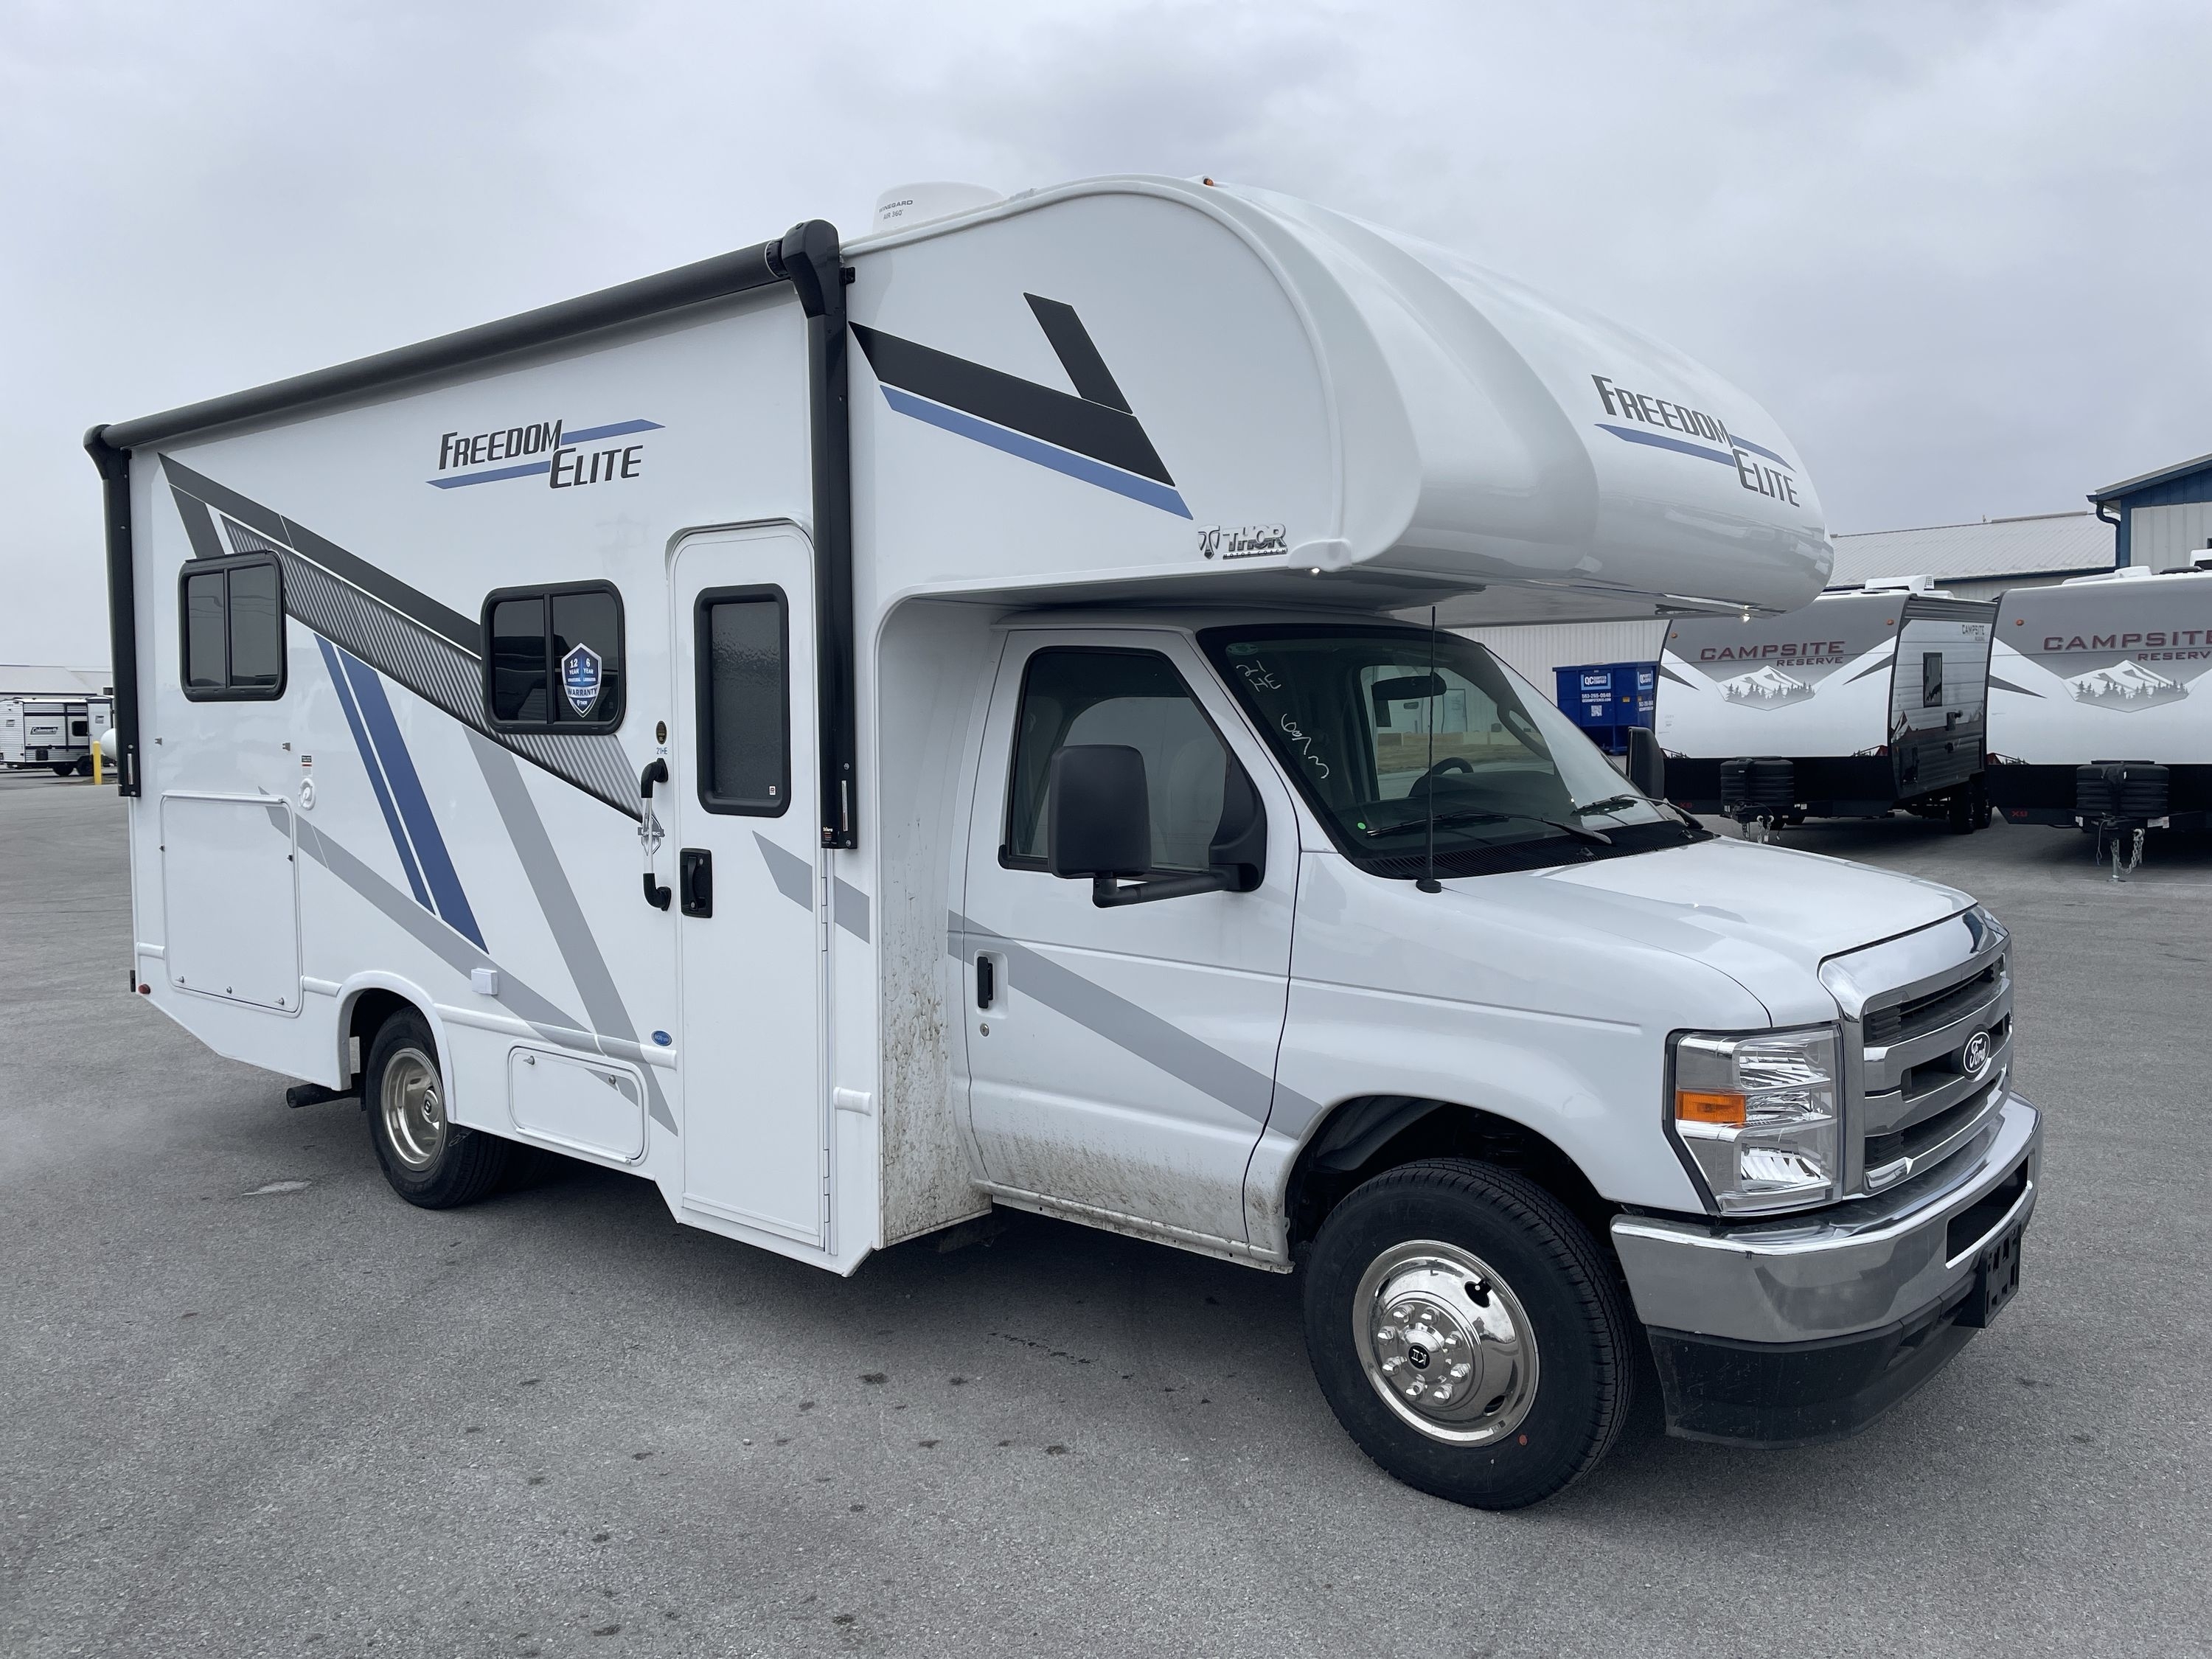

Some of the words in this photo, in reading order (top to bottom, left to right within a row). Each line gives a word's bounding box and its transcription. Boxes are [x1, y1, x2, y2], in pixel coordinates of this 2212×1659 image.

[878, 200, 914, 213] WINEGARD
[883, 212, 891, 220] AIR
[1590, 373, 1733, 448] FREEDOM
[439, 419, 563, 470] FREEDOM
[549, 445, 644, 490] ELITE
[1733, 448, 1801, 508] ELITE
[1222, 524, 1287, 552] THOR
[1222, 551, 1252, 559] MOTOR
[1256, 548, 1287, 556] COACH
[1700, 641, 1846, 661] CAMPSITE
[2138, 651, 2211, 661] RESERV
[570, 658, 578, 668] 12
[585, 658, 591, 667] 6
[1776, 656, 1844, 667] RESERVE
[1585, 676, 1594, 686] QC
[567, 687, 598, 697] WARRANTY
[656, 747, 668, 755] 21HE
[1969, 1037, 1986, 1068] Ford
